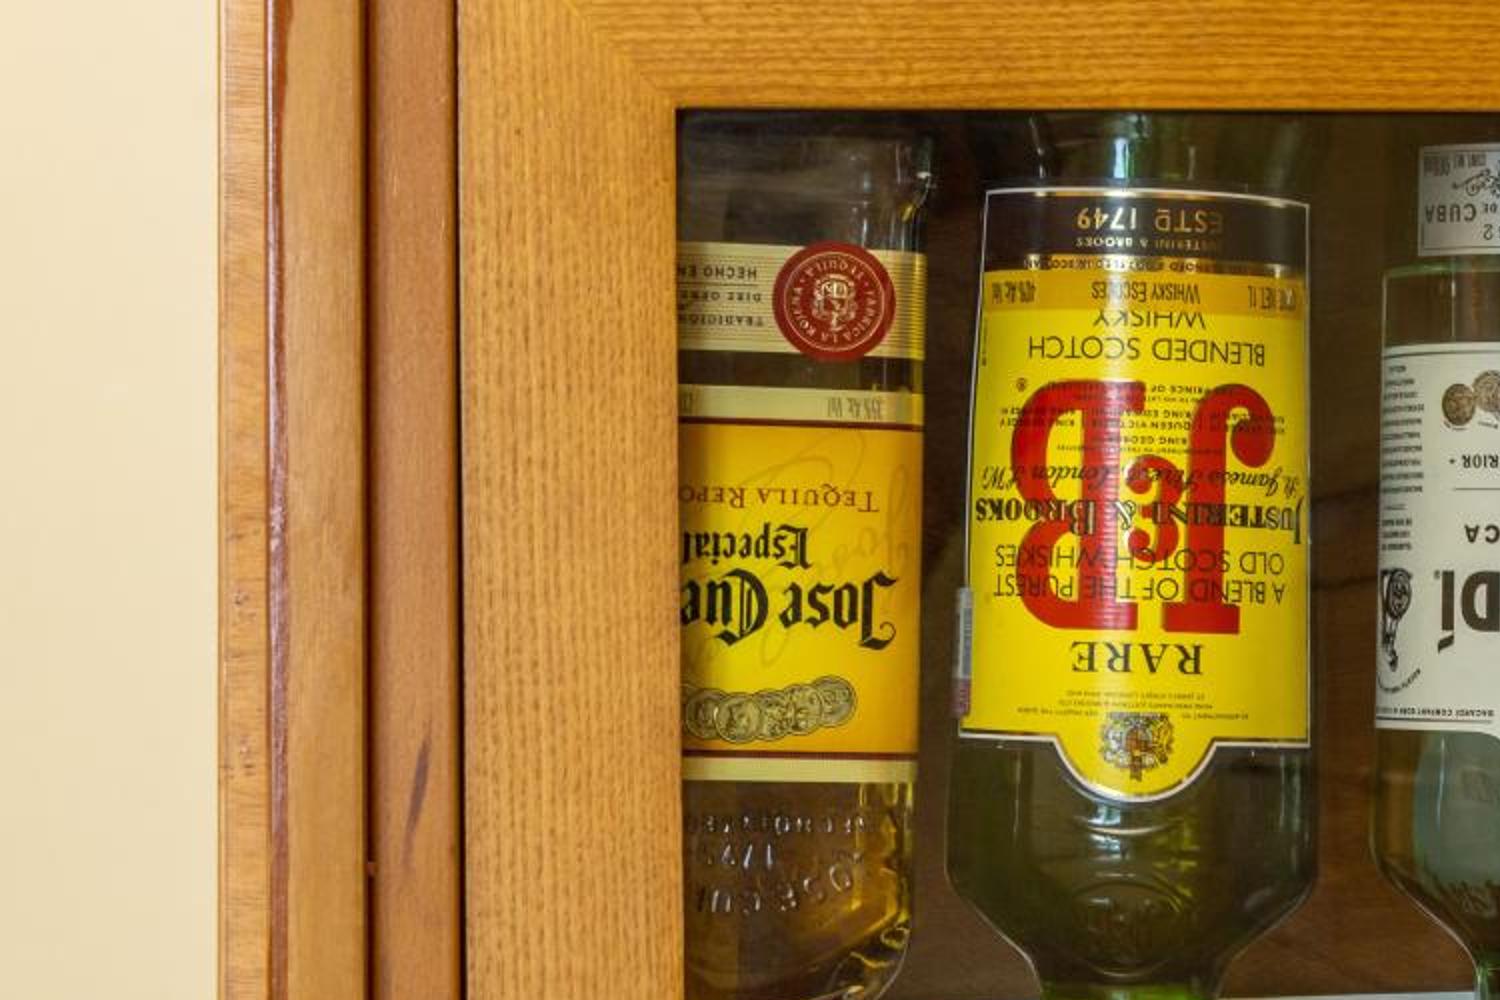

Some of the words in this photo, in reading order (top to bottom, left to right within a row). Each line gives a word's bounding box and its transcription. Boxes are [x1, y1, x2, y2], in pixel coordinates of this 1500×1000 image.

[1077, 207, 1137, 230] 1749
[1424, 202, 1476, 223] CUBA
[1483, 202, 1498, 213] DE
[1075, 236, 1133, 247] BROOKS
[1093, 309, 1205, 329] WHISKY
[1028, 335, 1140, 359] SCOTCH
[1152, 338, 1265, 366] BLENDED
[974, 498, 1096, 536] BROOKS
[1114, 501, 1135, 538] &
[682, 522, 811, 570] Especial
[994, 545, 1099, 569] WHISKIES
[1116, 547, 1231, 574] SCOTCH
[1239, 552, 1286, 576] OLD
[993, 574, 1074, 597] PUREST
[1083, 576, 1135, 598] THE
[1143, 577, 1179, 599] OF
[1187, 578, 1265, 601] BLEND
[1271, 583, 1285, 603] A
[778, 571, 897, 650] Jose
[1069, 640, 1203, 676] RARE
